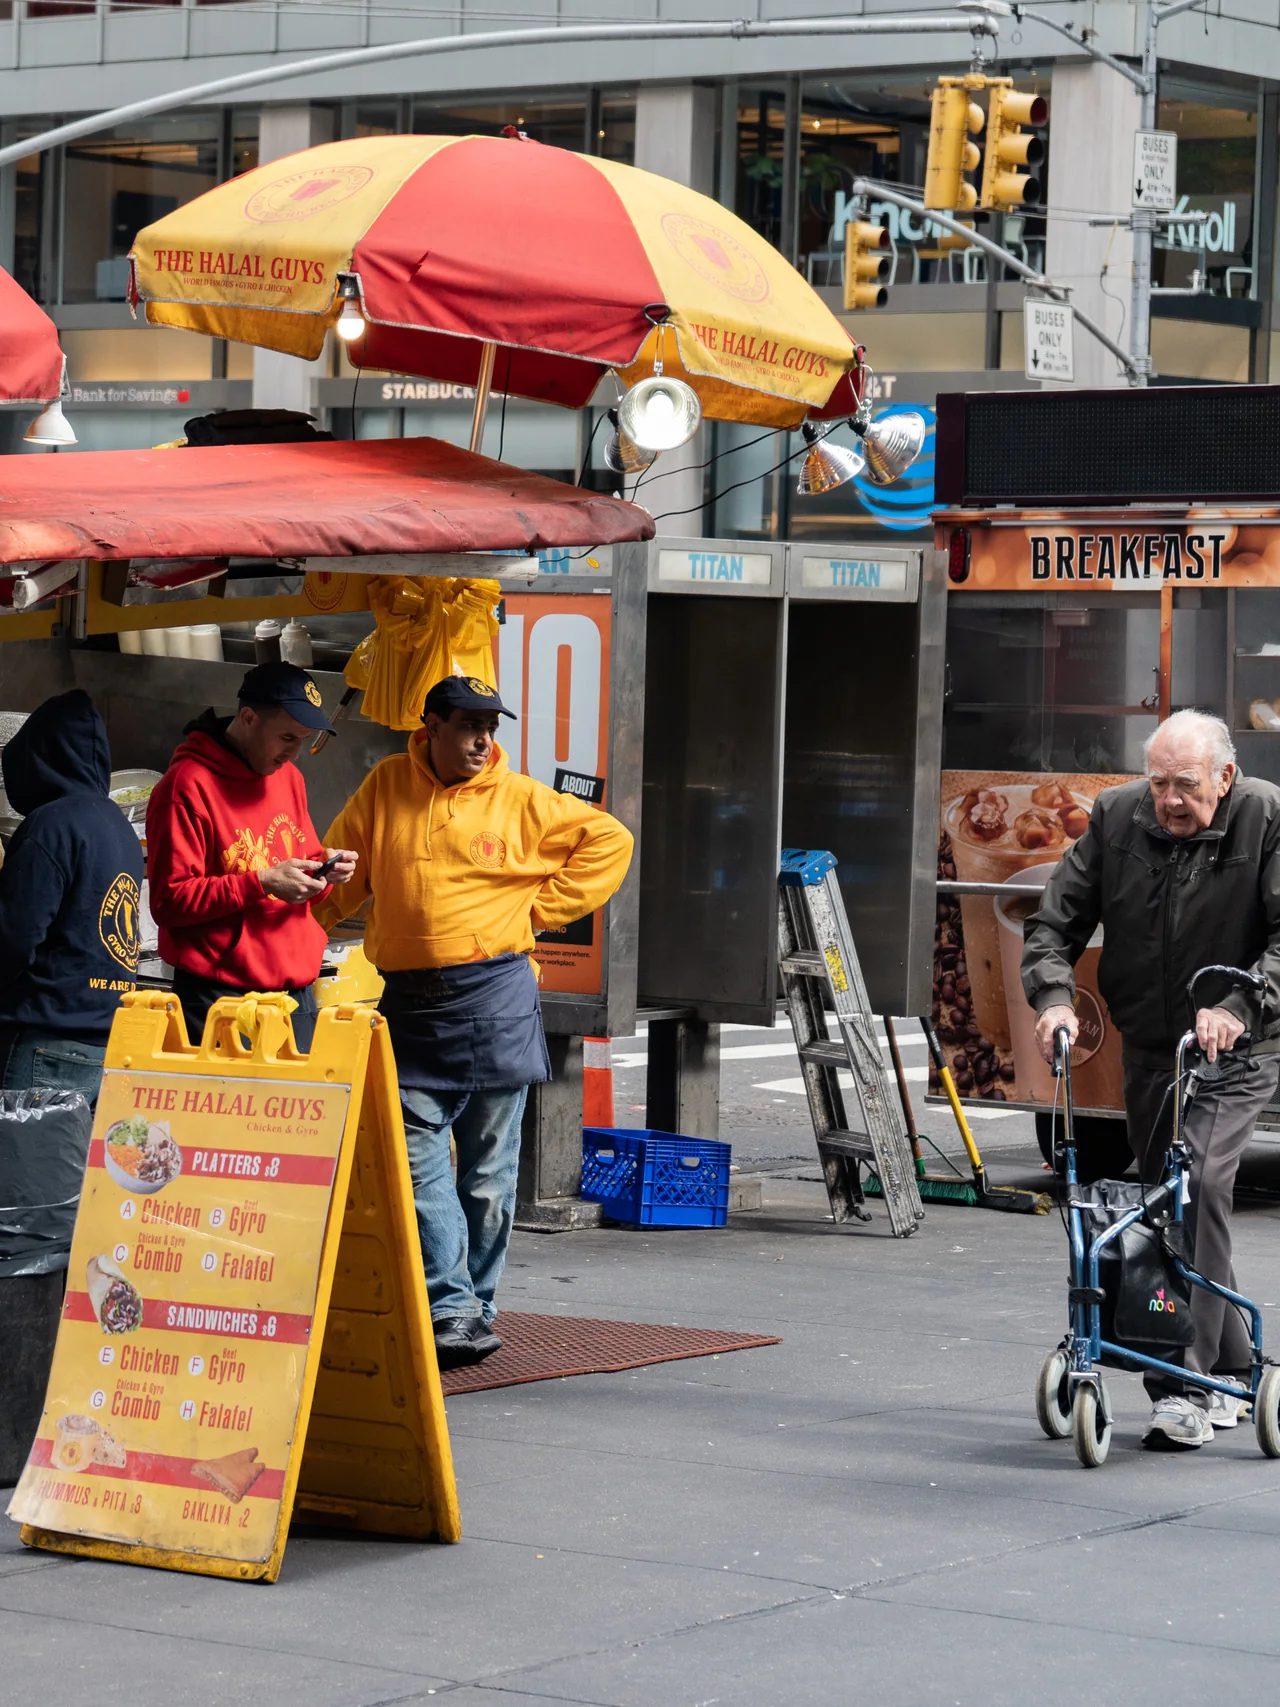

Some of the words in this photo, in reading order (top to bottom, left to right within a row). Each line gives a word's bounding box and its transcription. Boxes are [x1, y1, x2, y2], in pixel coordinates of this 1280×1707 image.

[1142, 136, 1169, 154] BUSES
[1143, 164, 1165, 180] ONLY
[153, 249, 195, 273] THE
[199, 250, 266, 278] HALAL
[183, 277, 210, 288] WORLD
[239, 282, 258, 293] GYRO
[264, 283, 293, 294] CHICKEN
[1034, 310, 1065, 327] BUSES
[721, 331, 780, 366] HALAL
[1038, 331, 1062, 347] ONLY
[73, 388, 107, 402] Bank
[108, 388, 127, 402] for
[127, 388, 179, 405] Savings
[688, 553, 744, 581] TITAN
[1030, 533, 1226, 581] BREAKFAST
[829, 560, 881, 588] TITAN
[560, 773, 597, 798] ABOUT
[265, 823, 277, 846] THE
[103, 889, 120, 918] THE
[107, 933, 128, 958] GYRO
[540, 948, 562, 957] happen
[561, 950, 592, 959] anywhere.
[546, 959, 577, 968] workplace.
[89, 977, 108, 990] WE
[108, 979, 130, 992] ARE
[132, 1086, 179, 1111] THE
[180, 1091, 258, 1118] HALAL
[246, 1121, 282, 1134] Chicken
[284, 1123, 293, 1134] &
[295, 1124, 319, 1137] Gyro
[191, 1151, 261, 1177] PLATTERS
[122, 1201, 133, 1217] A
[140, 1197, 201, 1229] Chicken
[211, 1209, 221, 1225] B
[229, 1206, 267, 1237] Gyro
[137, 1231, 162, 1246] Chicken
[169, 1235, 187, 1248] Gyro
[115, 1245, 126, 1261] C
[133, 1243, 183, 1274] Combo
[204, 1253, 215, 1270] D
[220, 1252, 276, 1282] Falafel
[166, 1305, 258, 1336] SANDWICHES
[101, 1346, 112, 1363] E
[119, 1344, 180, 1377] Chicken
[191, 1356, 202, 1373] F
[207, 1354, 246, 1385] Gyro
[222, 1347, 238, 1360] Beef
[115, 1378, 141, 1393] Chicken
[141, 1381, 148, 1393] &
[148, 1382, 165, 1395] Gyro
[92, 1390, 105, 1408] G
[110, 1390, 162, 1422] Combo
[182, 1402, 193, 1419] H
[198, 1400, 254, 1432] Falafel
[37, 1480, 91, 1507] HUMMUS
[101, 1489, 127, 1512] PITA
[182, 1500, 231, 1526] BAKLAVA
